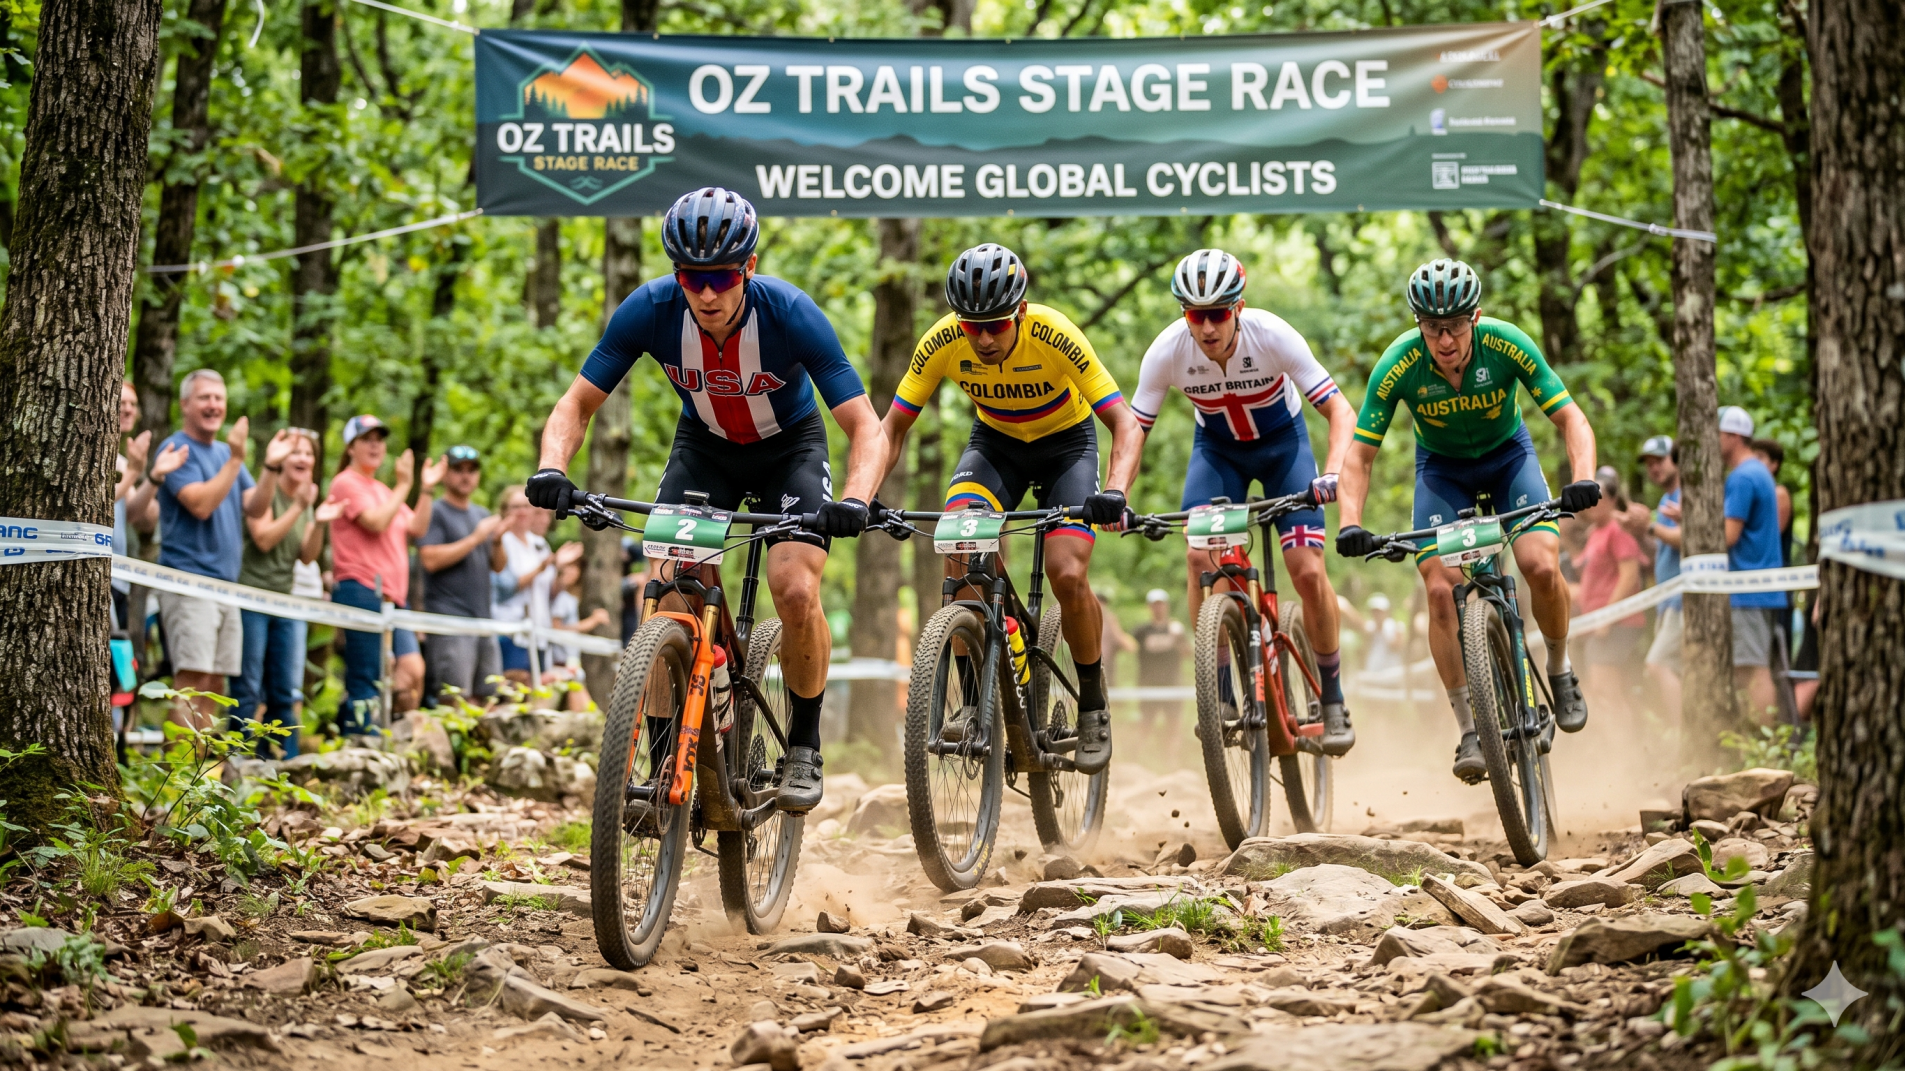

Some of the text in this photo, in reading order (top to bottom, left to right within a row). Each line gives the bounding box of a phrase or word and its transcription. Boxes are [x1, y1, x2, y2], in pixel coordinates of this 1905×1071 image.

[689, 59, 1391, 114] OZ TRAILS STAGE RACE
[496, 122, 676, 155] OZ TRAILS
[532, 155, 640, 172] STAGE RACE
[756, 159, 1338, 199] WELCOME GLOBAL CYCLISTS
[911, 323, 966, 376] COLOMBIA
[1030, 321, 1092, 375] COLOMBIA
[1481, 333, 1537, 376] AUSTRALIA
[663, 363, 787, 397] USA
[959, 380, 1056, 399] COLOMBIA
[1183, 376, 1275, 395] GREAT BRITAIN
[1376, 347, 1422, 401] AUSTRALIA
[1416, 388, 1507, 417] AUSTRALIA
[675, 518, 698, 541] 2
[960, 519, 979, 537] 3
[1210, 514, 1226, 532] 2
[1461, 528, 1477, 547] 3
